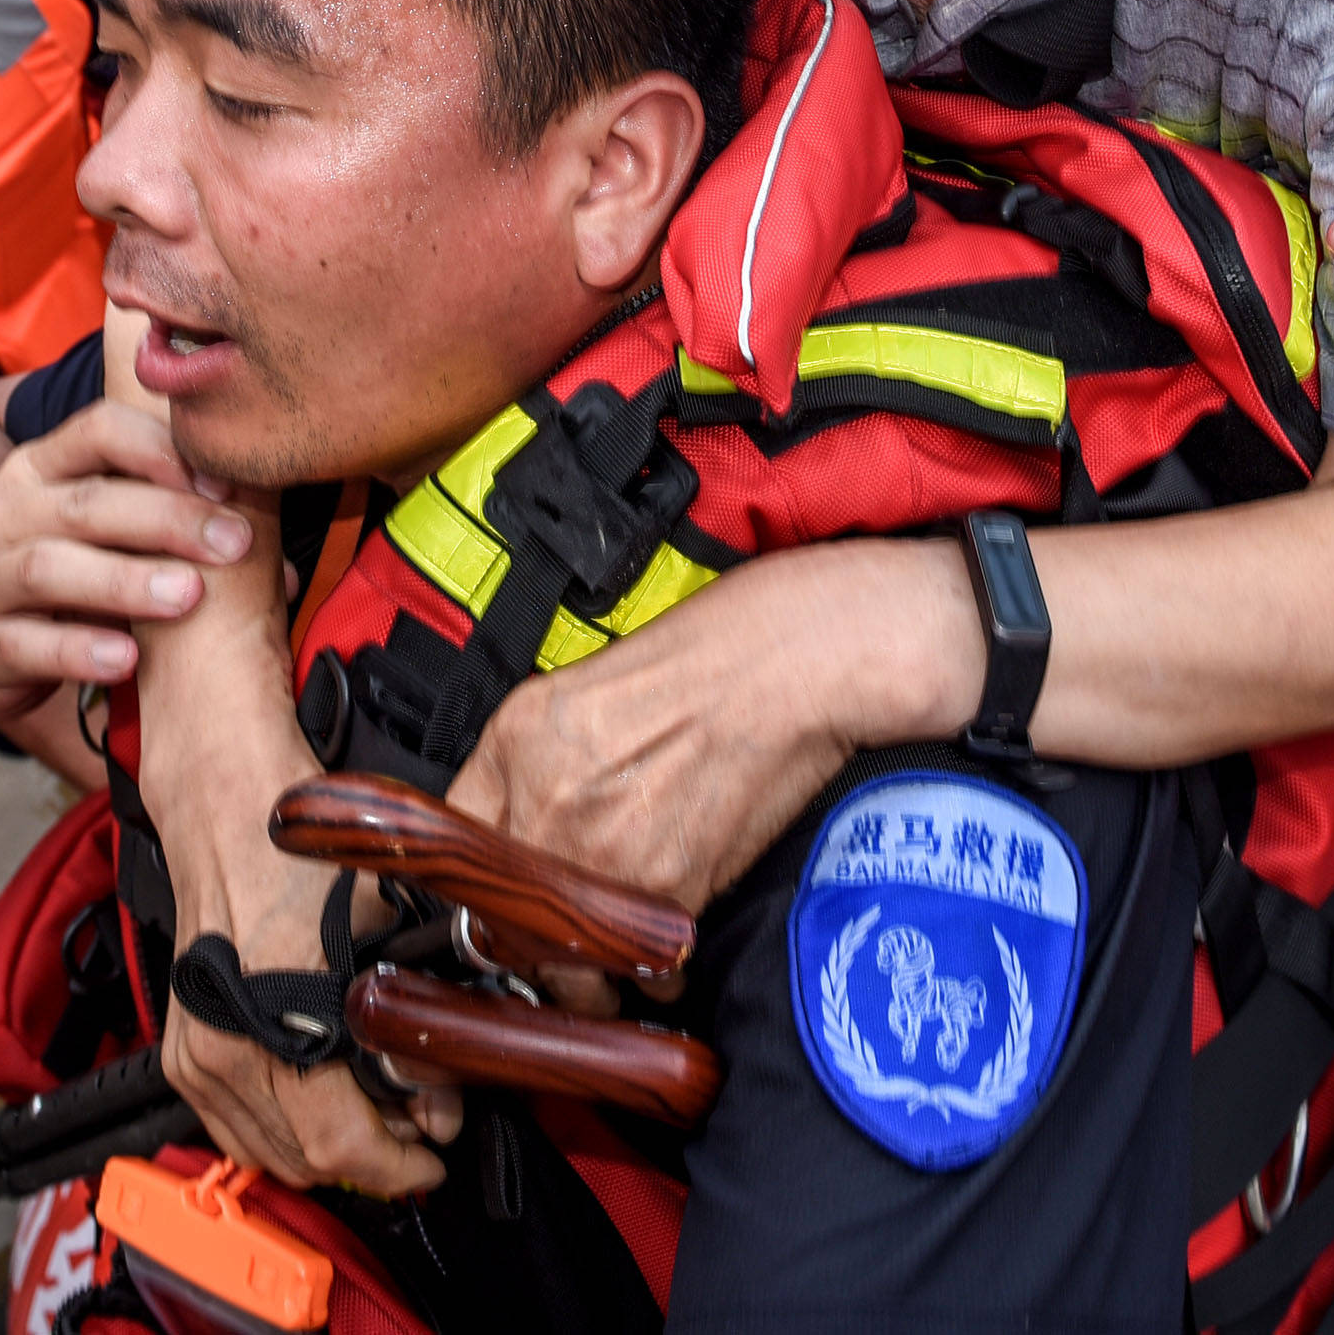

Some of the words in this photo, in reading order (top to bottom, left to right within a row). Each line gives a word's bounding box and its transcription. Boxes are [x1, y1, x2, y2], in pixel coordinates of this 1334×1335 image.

[834, 859, 888, 885] BAN
[895, 858, 933, 886] MA
[841, 811, 1045, 884] 斑马救援
